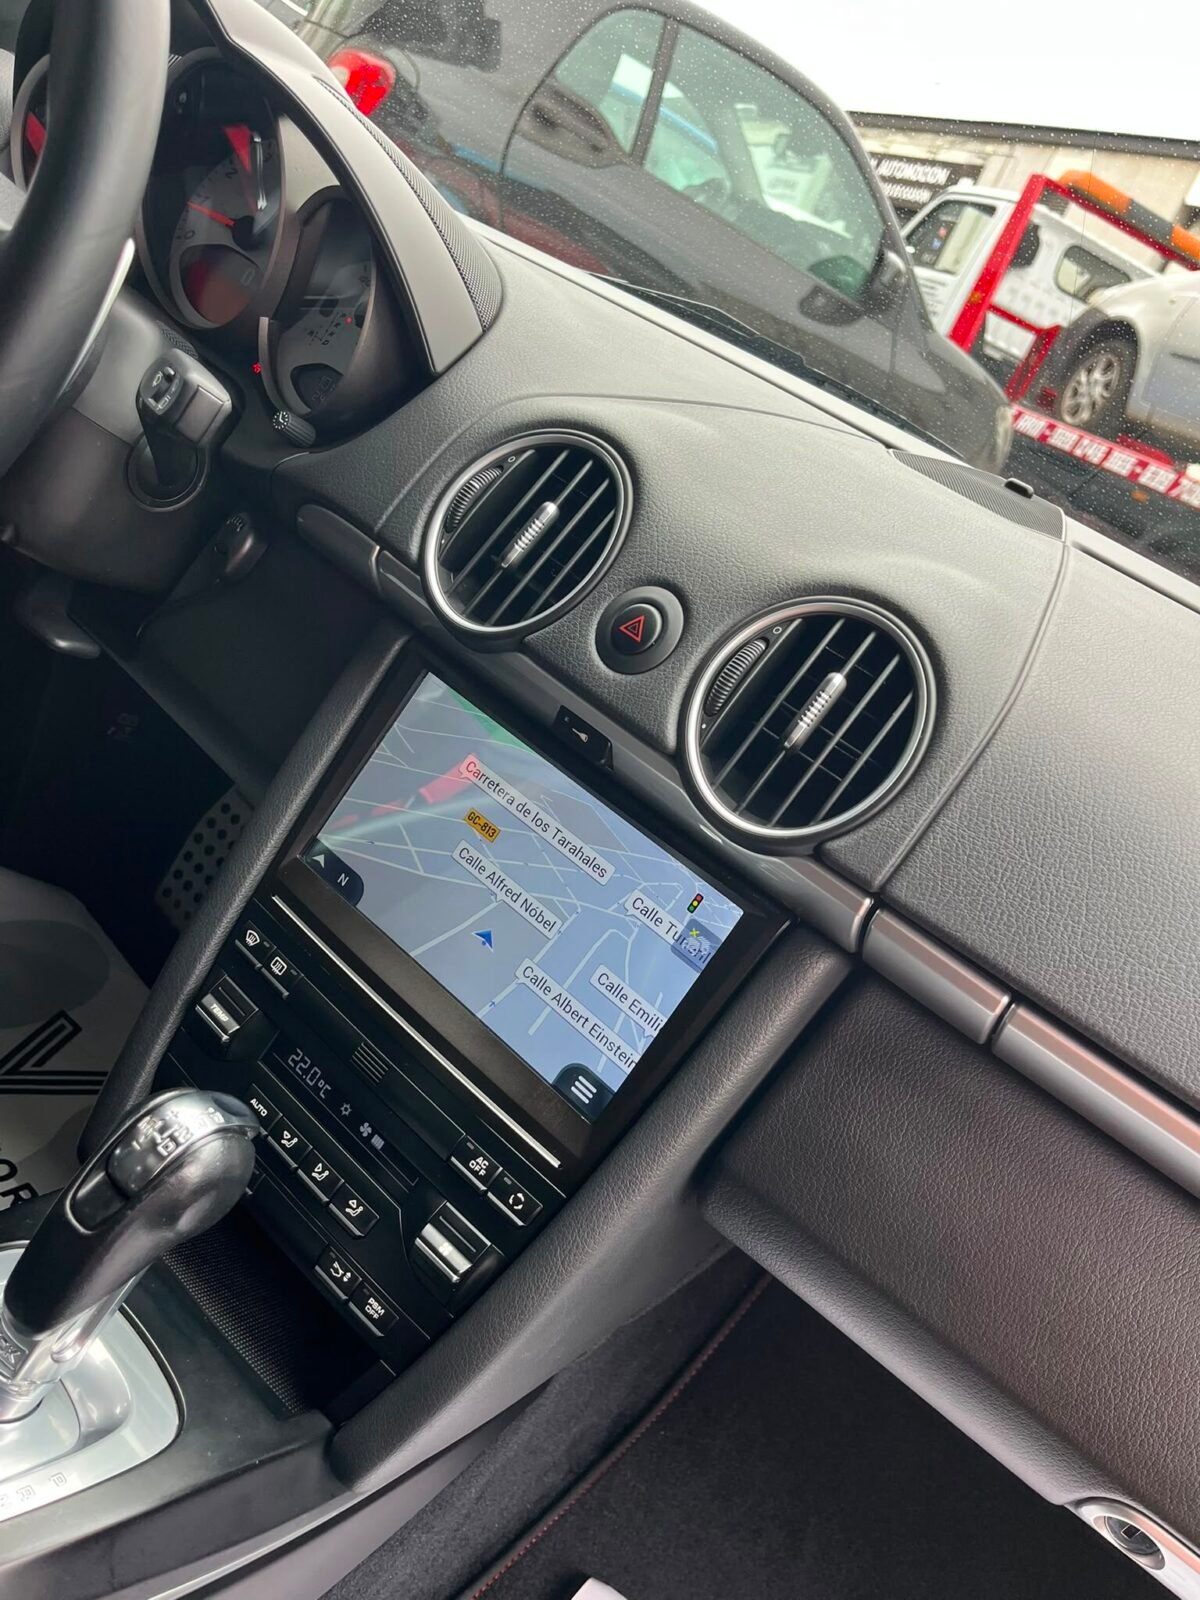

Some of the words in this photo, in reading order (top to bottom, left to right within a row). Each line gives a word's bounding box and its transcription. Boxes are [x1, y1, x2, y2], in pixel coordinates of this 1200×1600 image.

[466, 760, 516, 806] Carretera
[515, 801, 531, 818] de
[531, 811, 550, 833] los
[551, 826, 607, 878] Tarahales
[467, 810, 497, 838] GC-813
[337, 872, 349, 887] N
[458, 847, 487, 875] Calle
[485, 871, 522, 903] Alfred
[520, 898, 557, 932] Nóbel
[632, 897, 663, 928] Calle
[522, 965, 552, 996] Calle
[551, 992, 590, 1028] Albert
[597, 972, 629, 1004] Calle
[210, 1003, 230, 1022] TEMP
[250, 1098, 268, 1117] AUTO
[468, 1159, 486, 1176] OFF
[475, 1156, 489, 1169] AC
[364, 1305, 380, 1319] OFF
[367, 1297, 385, 1316] PSM
